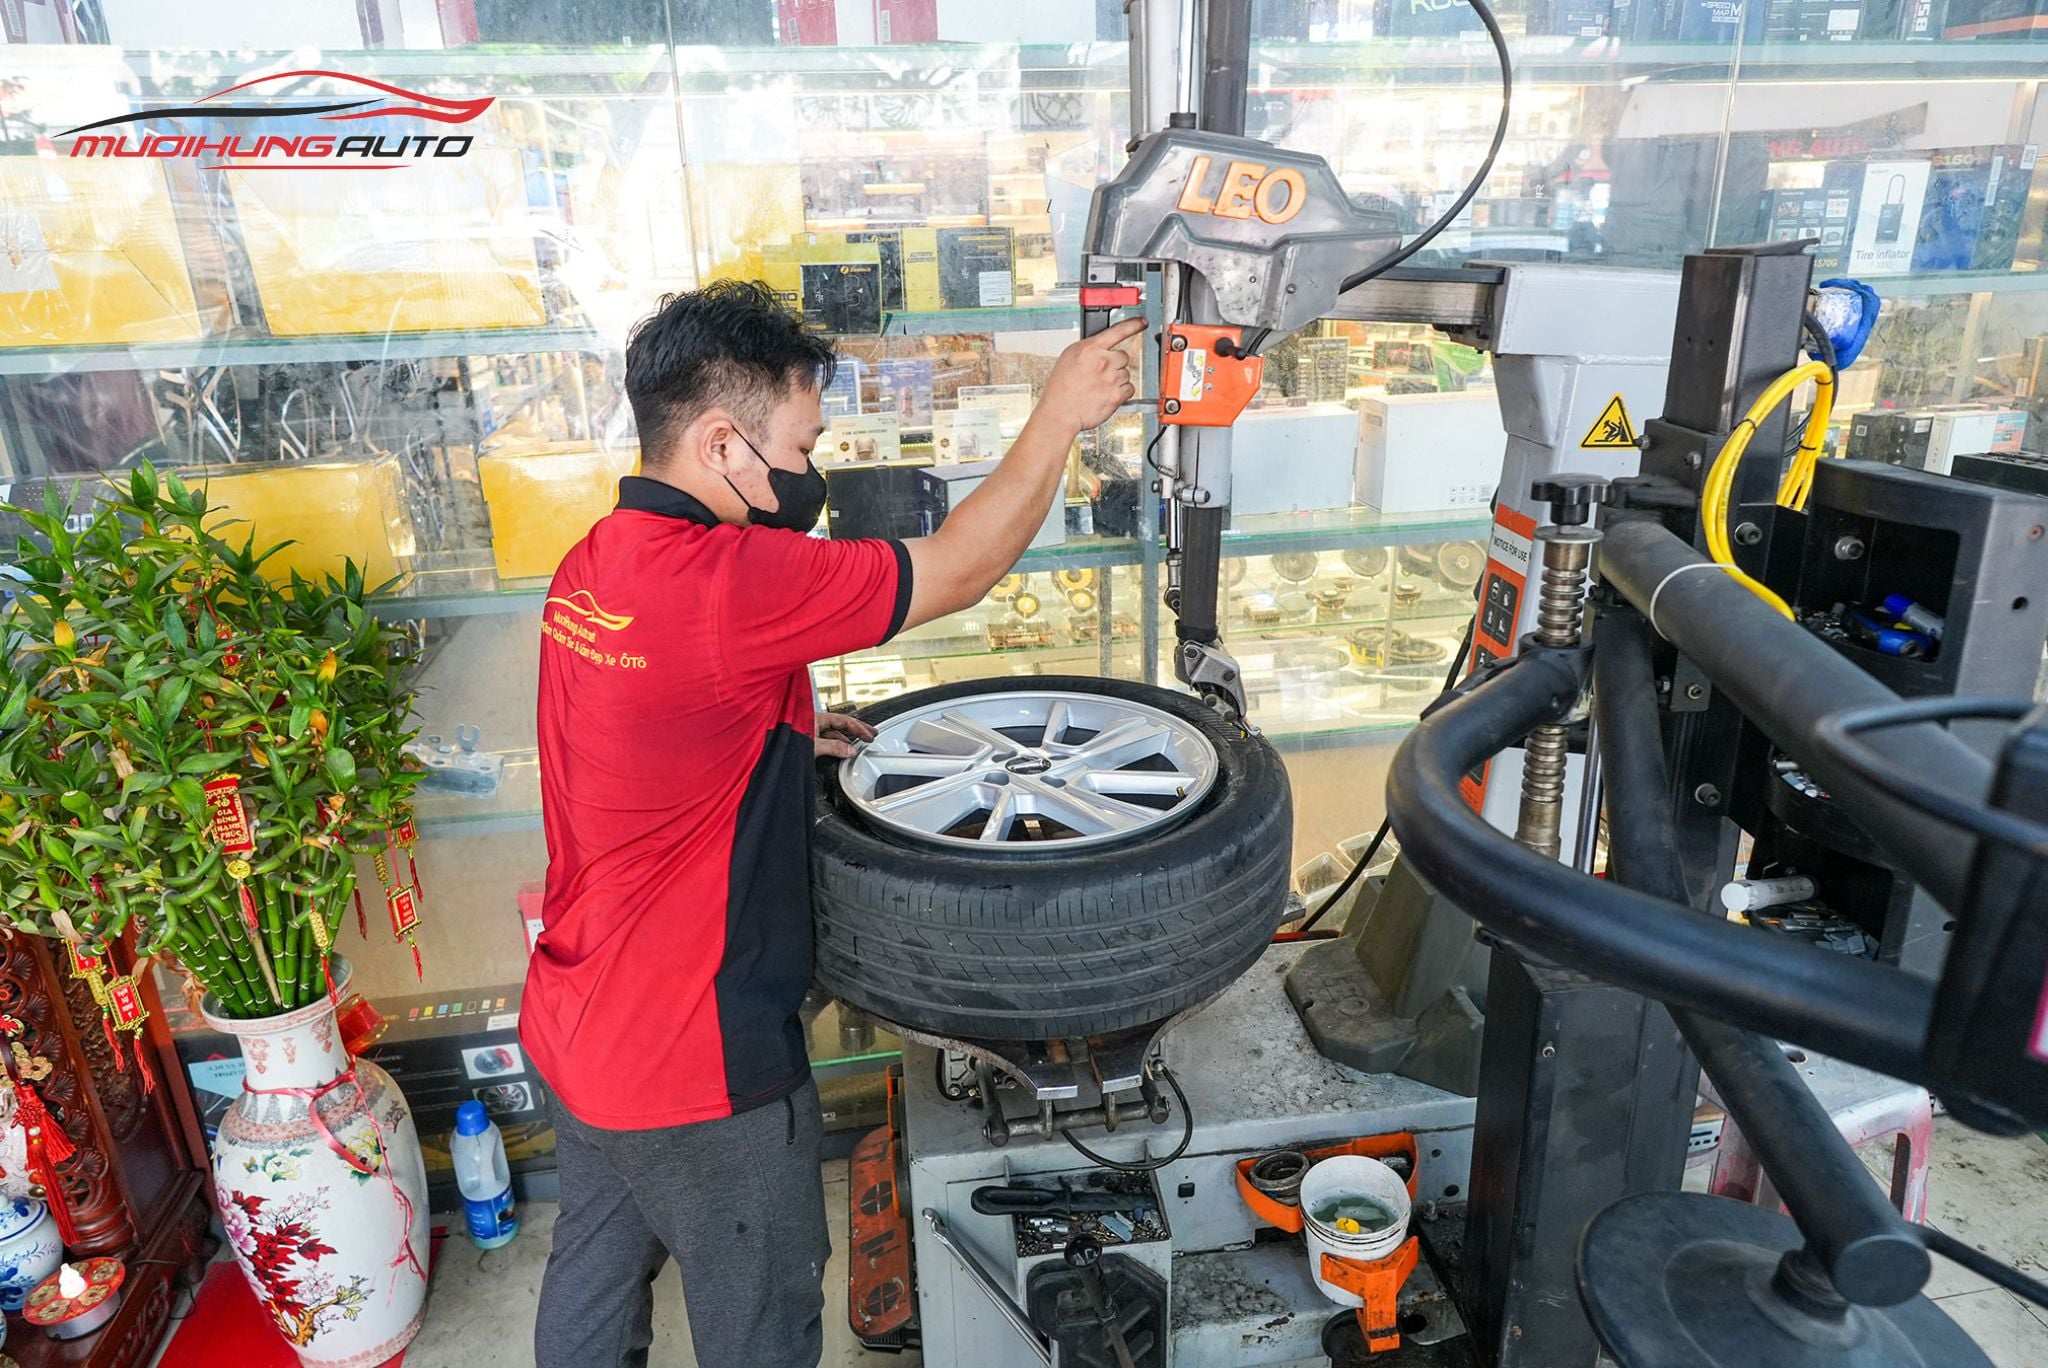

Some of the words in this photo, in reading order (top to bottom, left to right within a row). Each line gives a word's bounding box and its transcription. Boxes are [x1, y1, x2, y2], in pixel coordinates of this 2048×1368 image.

[1177, 155, 1308, 225] LEO
[1856, 249, 1874, 260] Tire
[1494, 536, 1509, 552] NOTICE
[1509, 543, 1518, 557] FOR
[1518, 550, 1528, 562] USE
